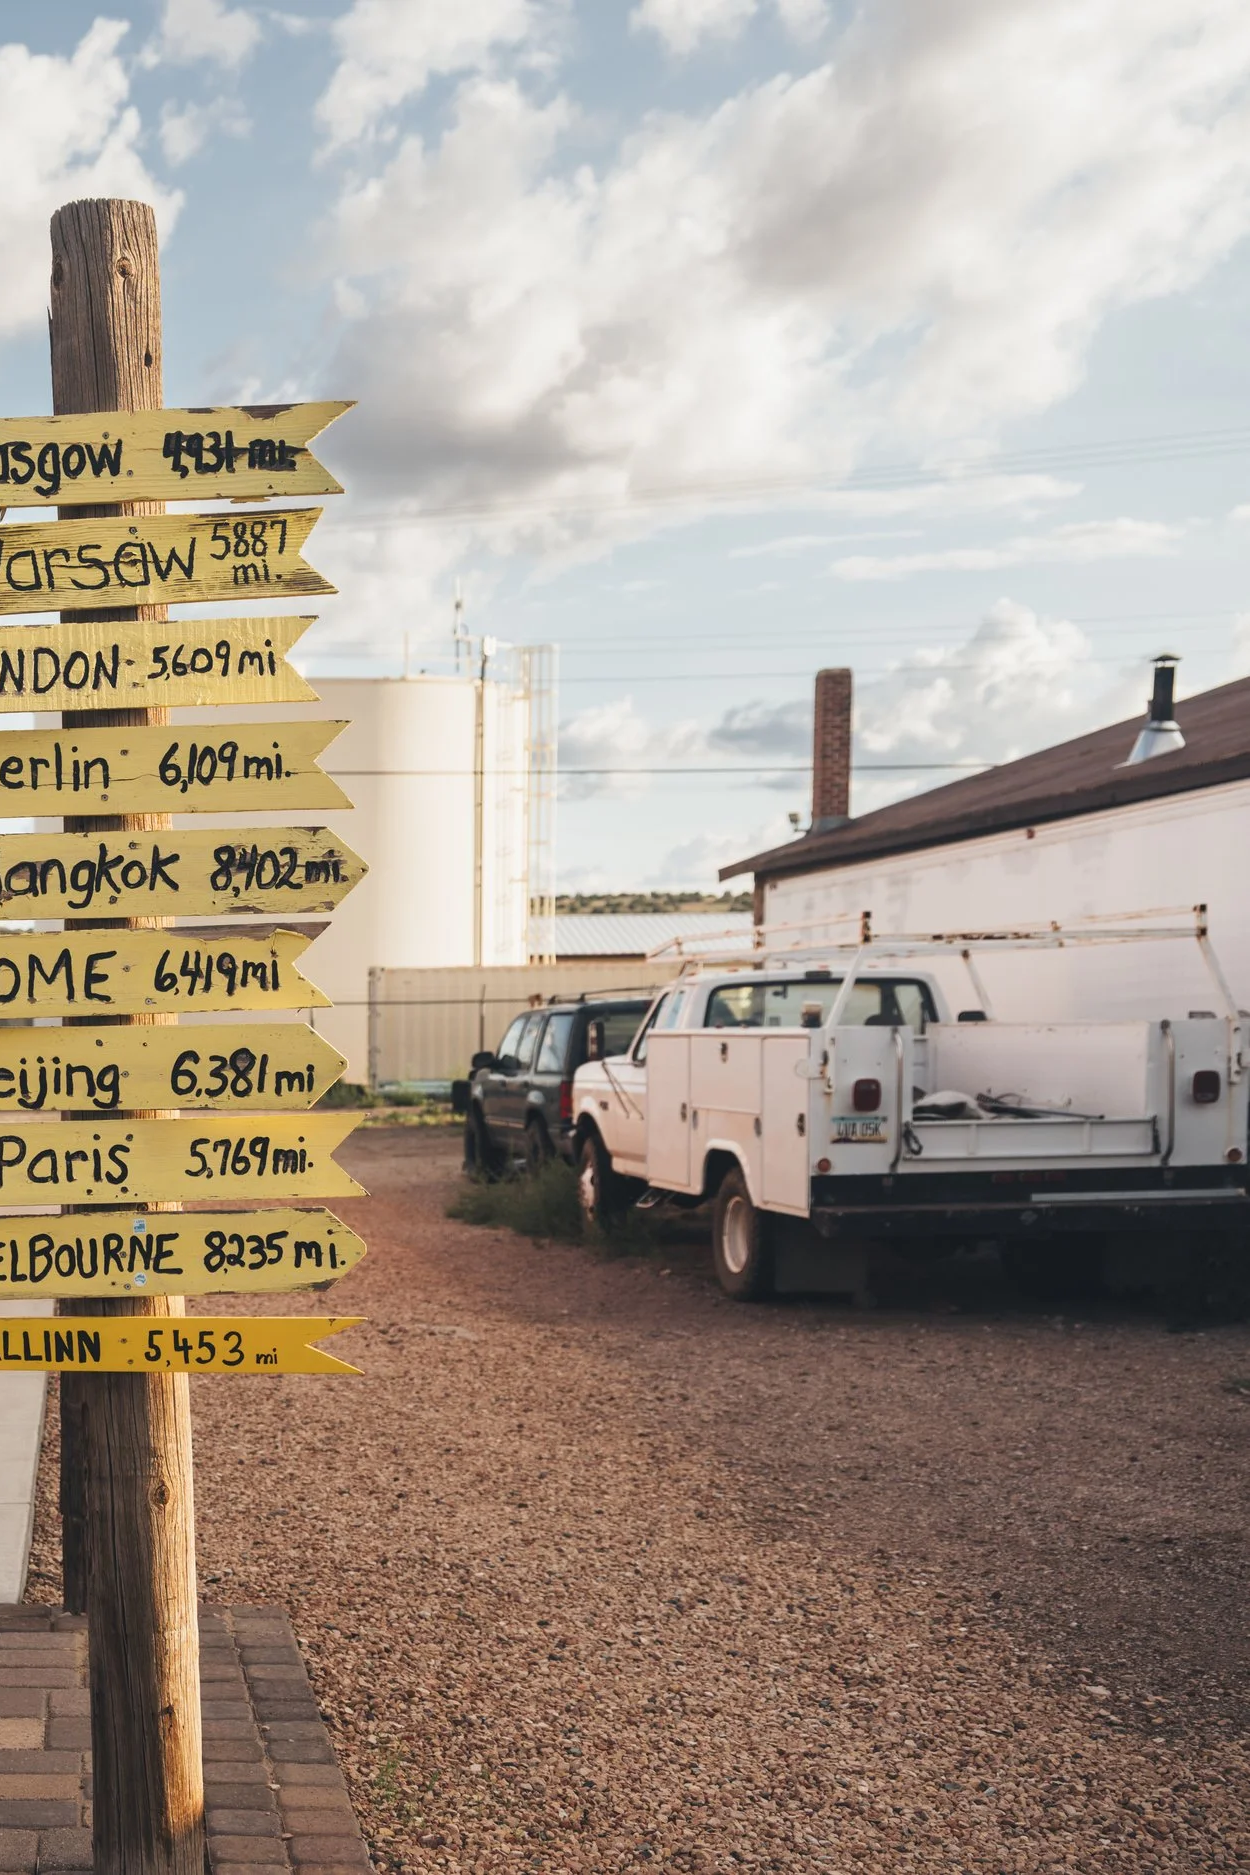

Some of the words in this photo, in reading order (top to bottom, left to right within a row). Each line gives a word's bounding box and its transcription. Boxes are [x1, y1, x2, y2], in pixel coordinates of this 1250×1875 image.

[210, 519, 287, 561] 5887
[274, 1064, 315, 1097] mi
[144, 1329, 245, 1368] 5,453
[255, 1347, 279, 1365] mi
